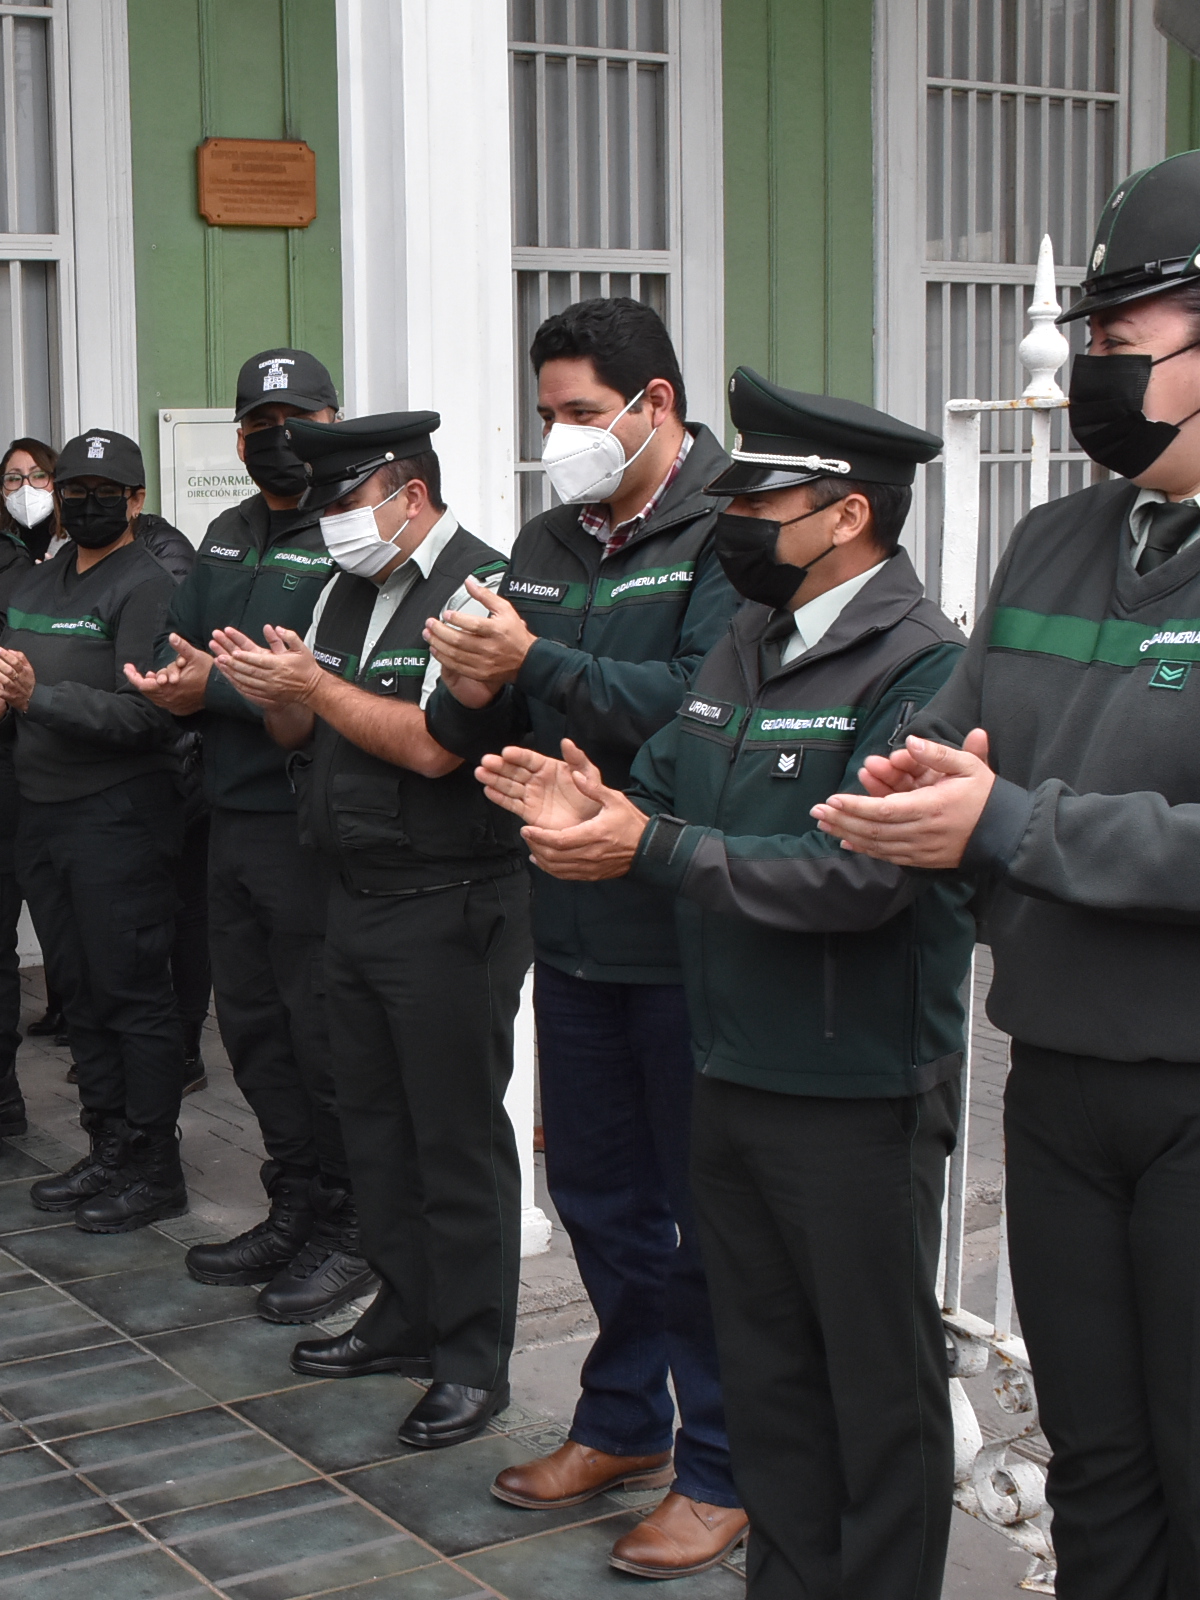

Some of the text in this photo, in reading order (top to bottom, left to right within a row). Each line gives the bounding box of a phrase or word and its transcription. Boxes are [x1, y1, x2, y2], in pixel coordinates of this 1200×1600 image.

[187, 488, 260, 498] DIRECCIÓN REGIO
[210, 545, 240, 557] CACERES
[657, 574, 669, 585] DE
[670, 571, 694, 582] CHILE
[508, 581, 560, 598] SAAVEDRA
[394, 657, 402, 666] DE
[403, 657, 425, 666] CHILE
[688, 700, 722, 720] URRUTIA
[813, 717, 827, 728] DE
[826, 716, 857, 731] CHILE
